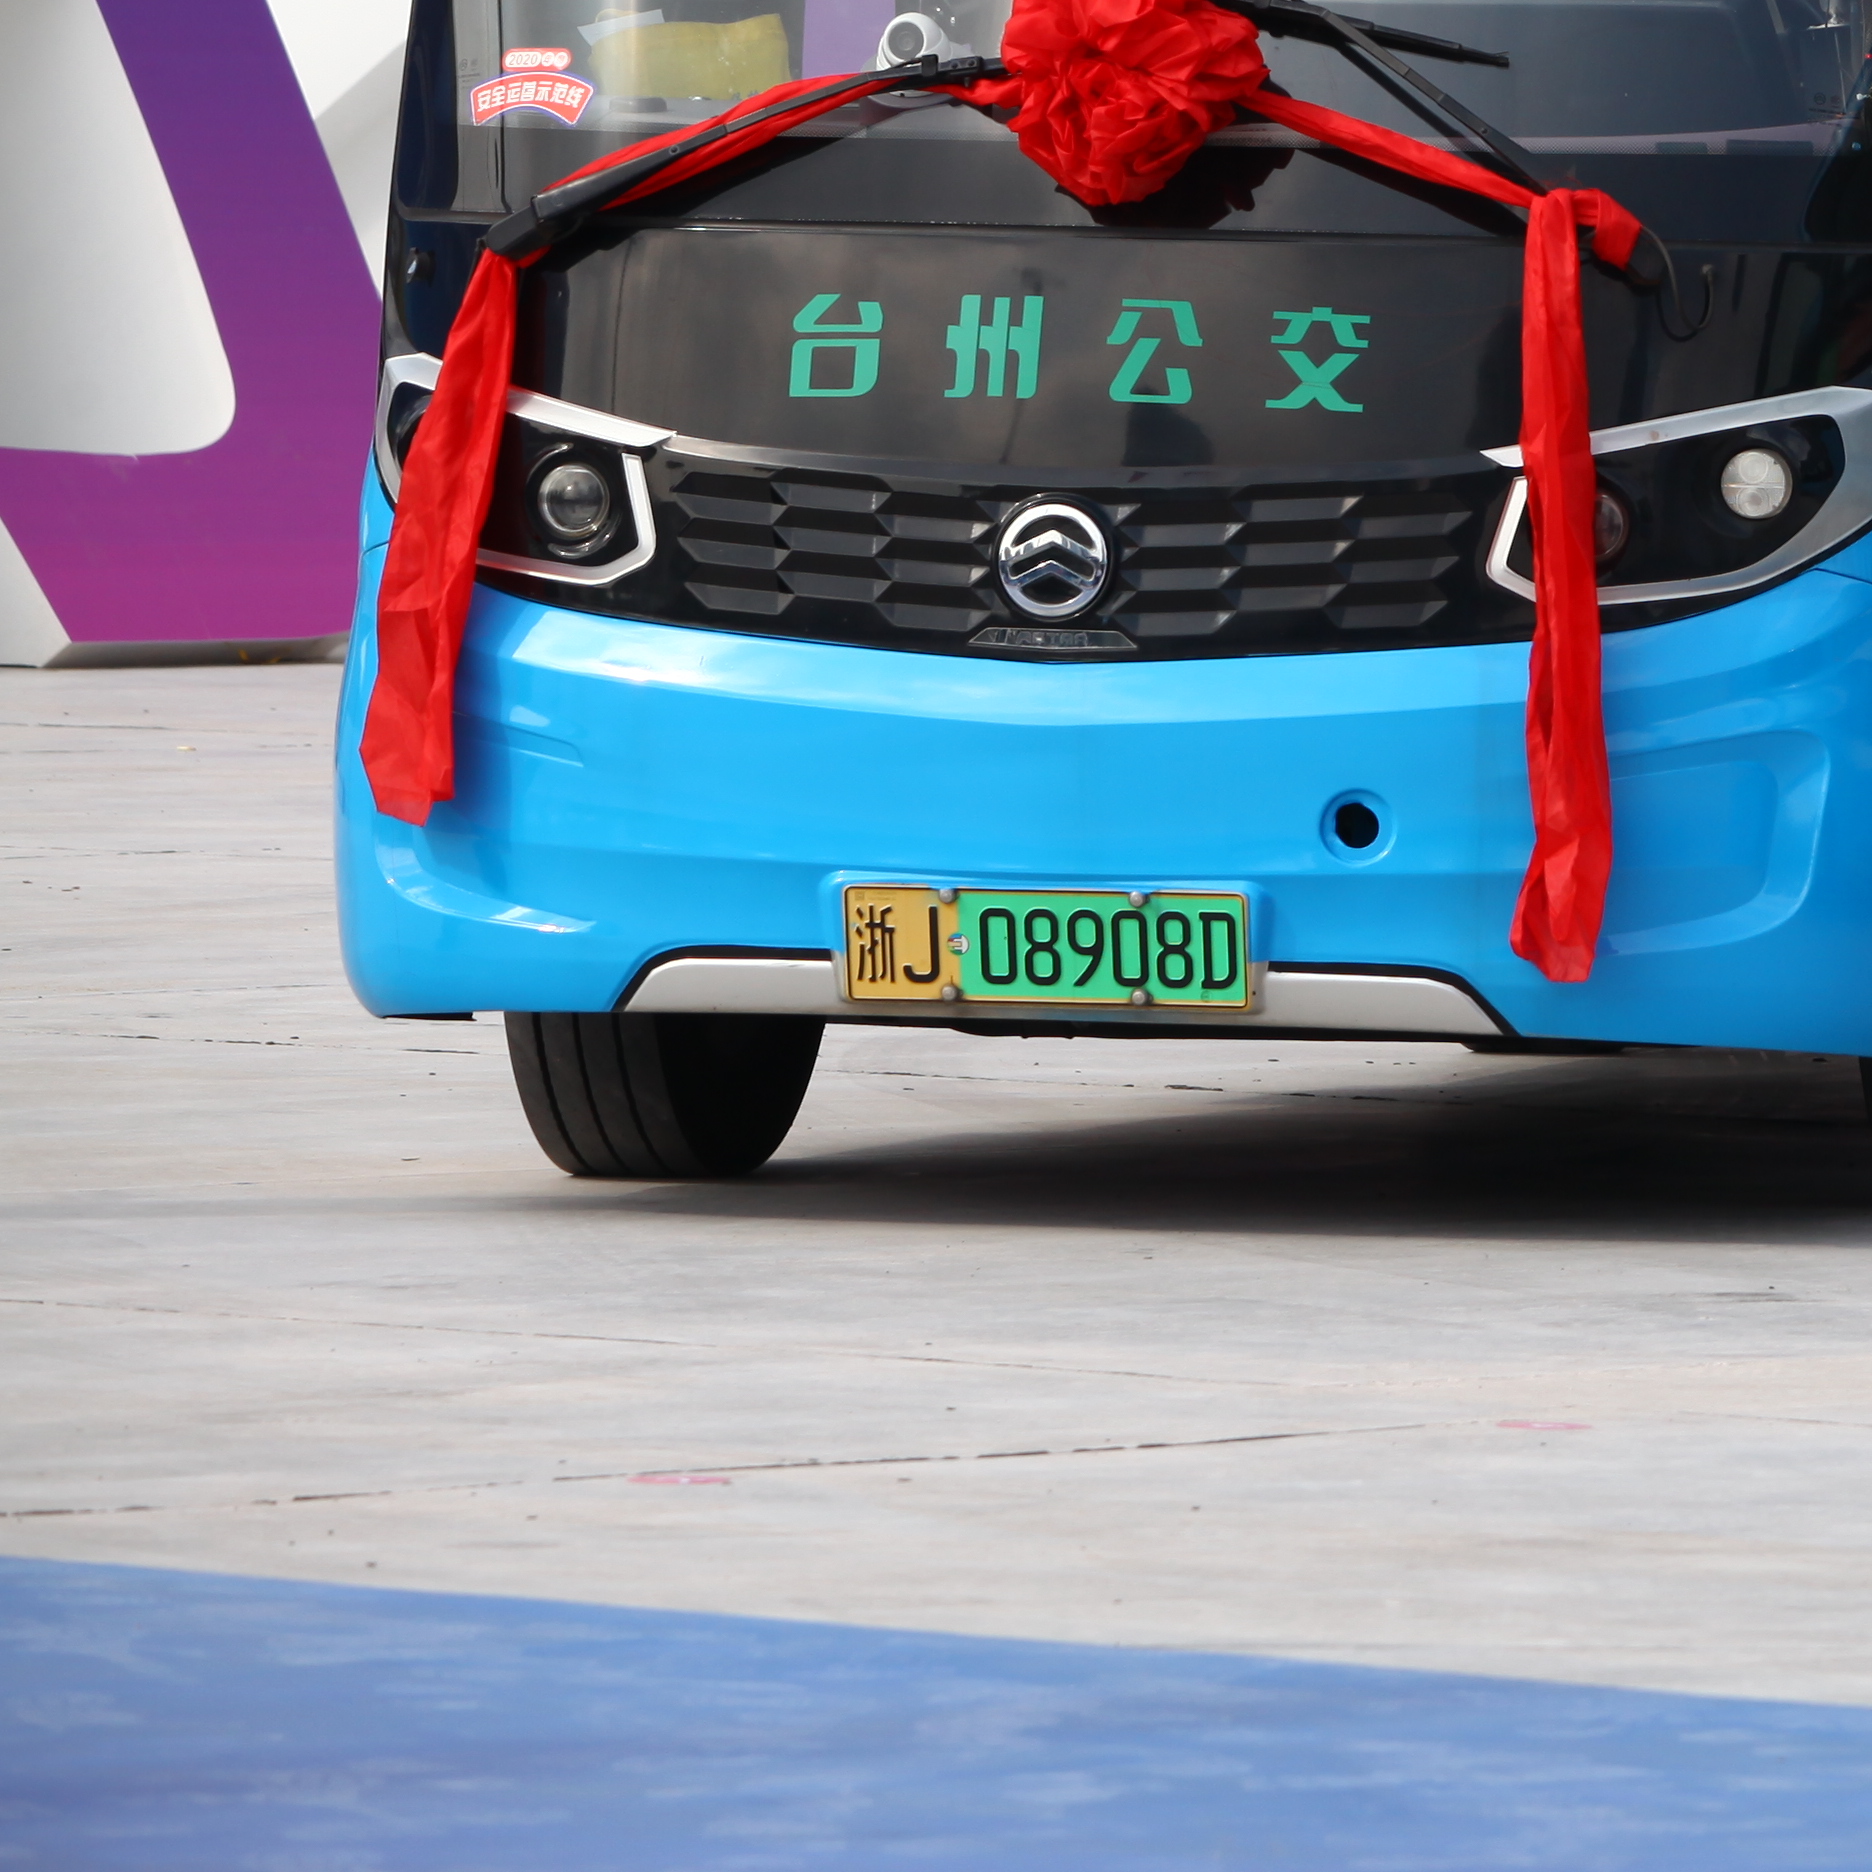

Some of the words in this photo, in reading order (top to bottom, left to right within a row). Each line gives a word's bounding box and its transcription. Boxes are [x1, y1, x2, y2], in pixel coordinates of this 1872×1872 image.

[477, 81, 585, 112] 安全运营示范线
[789, 293, 1371, 414] 台州公交
[855, 904, 940, 984] 浙J
[979, 906, 1238, 990] 08908D
